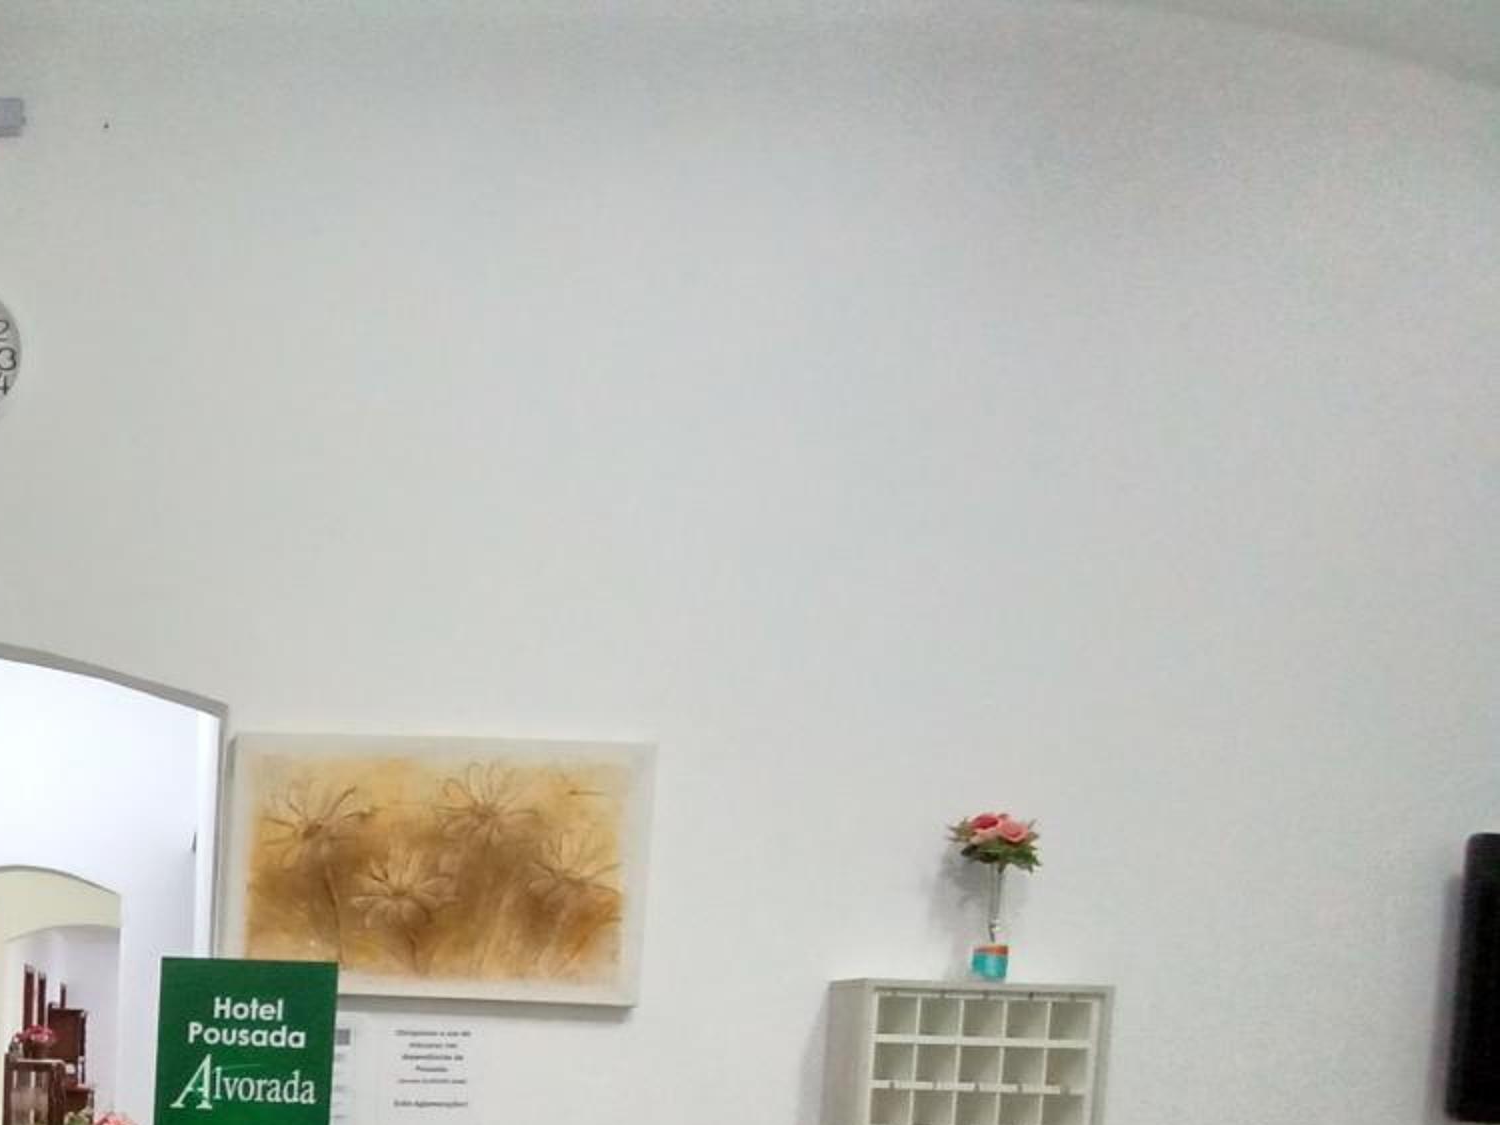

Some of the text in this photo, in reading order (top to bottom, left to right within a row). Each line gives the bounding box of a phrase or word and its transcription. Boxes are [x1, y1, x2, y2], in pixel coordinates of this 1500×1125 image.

[213, 996, 284, 1021] Hotel
[188, 1021, 306, 1048] Pousada
[169, 1053, 316, 1110] Alvorada
